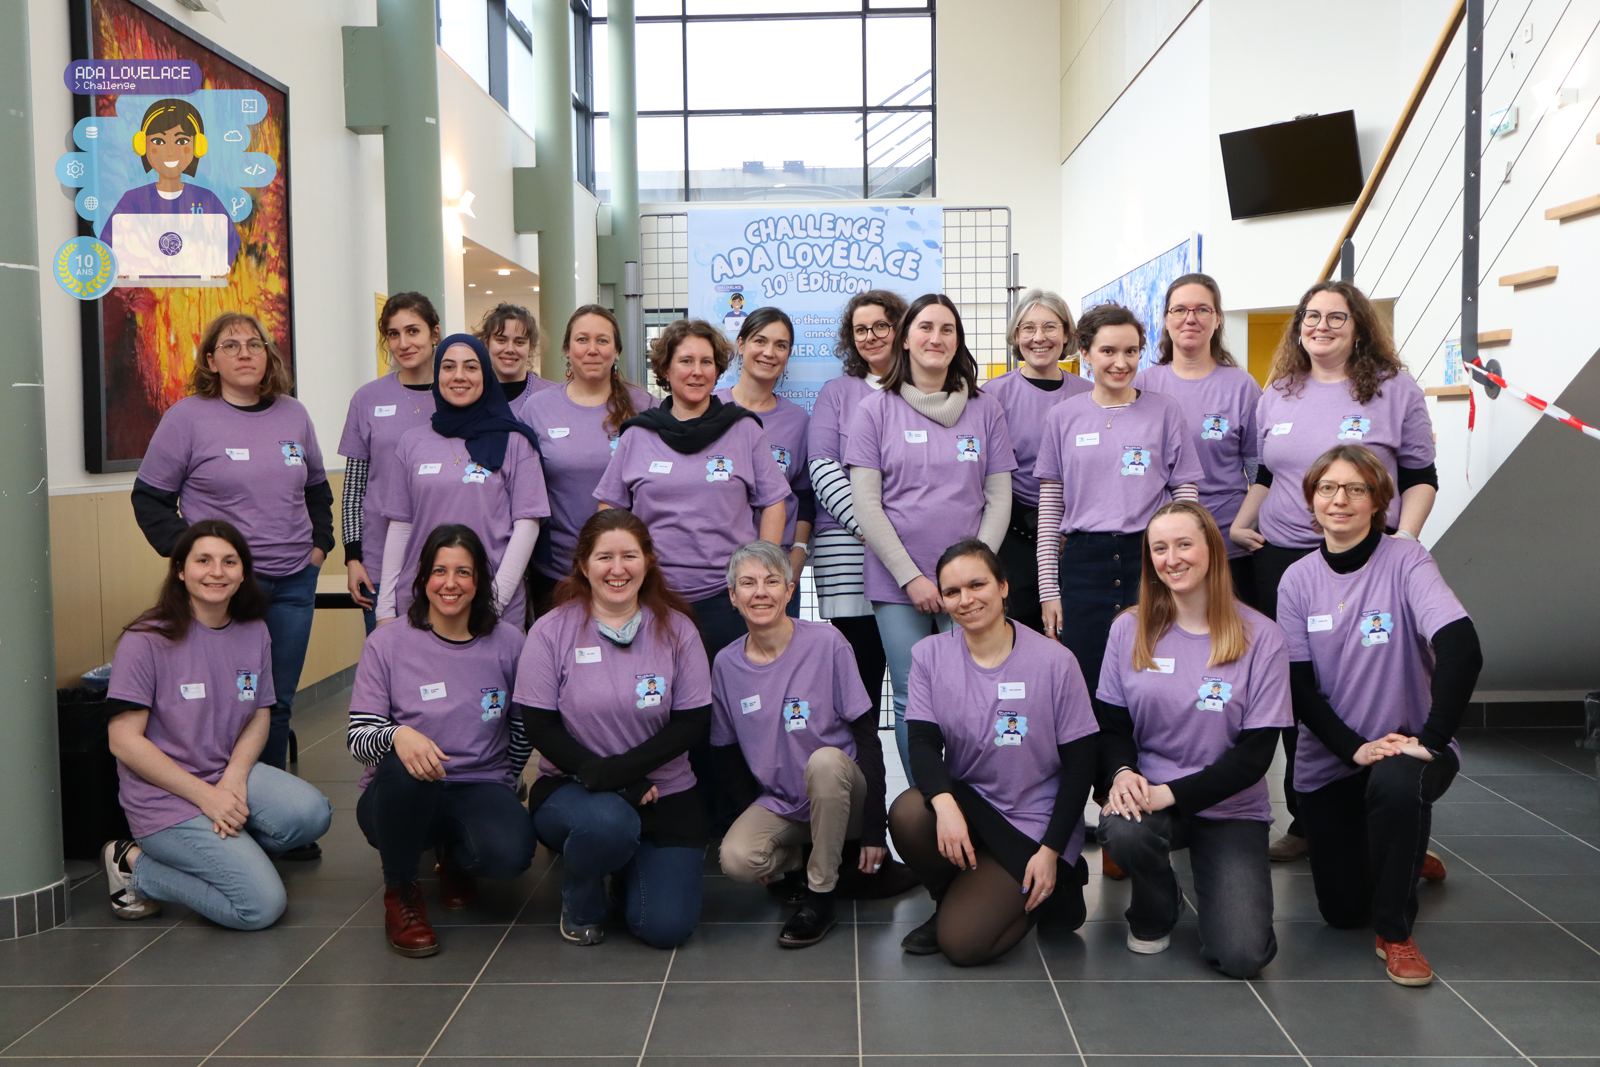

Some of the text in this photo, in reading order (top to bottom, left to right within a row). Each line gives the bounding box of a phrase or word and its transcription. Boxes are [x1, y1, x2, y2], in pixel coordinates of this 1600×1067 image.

[744, 212, 886, 246] CHALLENGE
[711, 238, 922, 283] ADA LOVELACE
[789, 314, 801, 325] Le
[803, 313, 837, 325] thème
[804, 328, 836, 338] année
[818, 343, 831, 357] &
